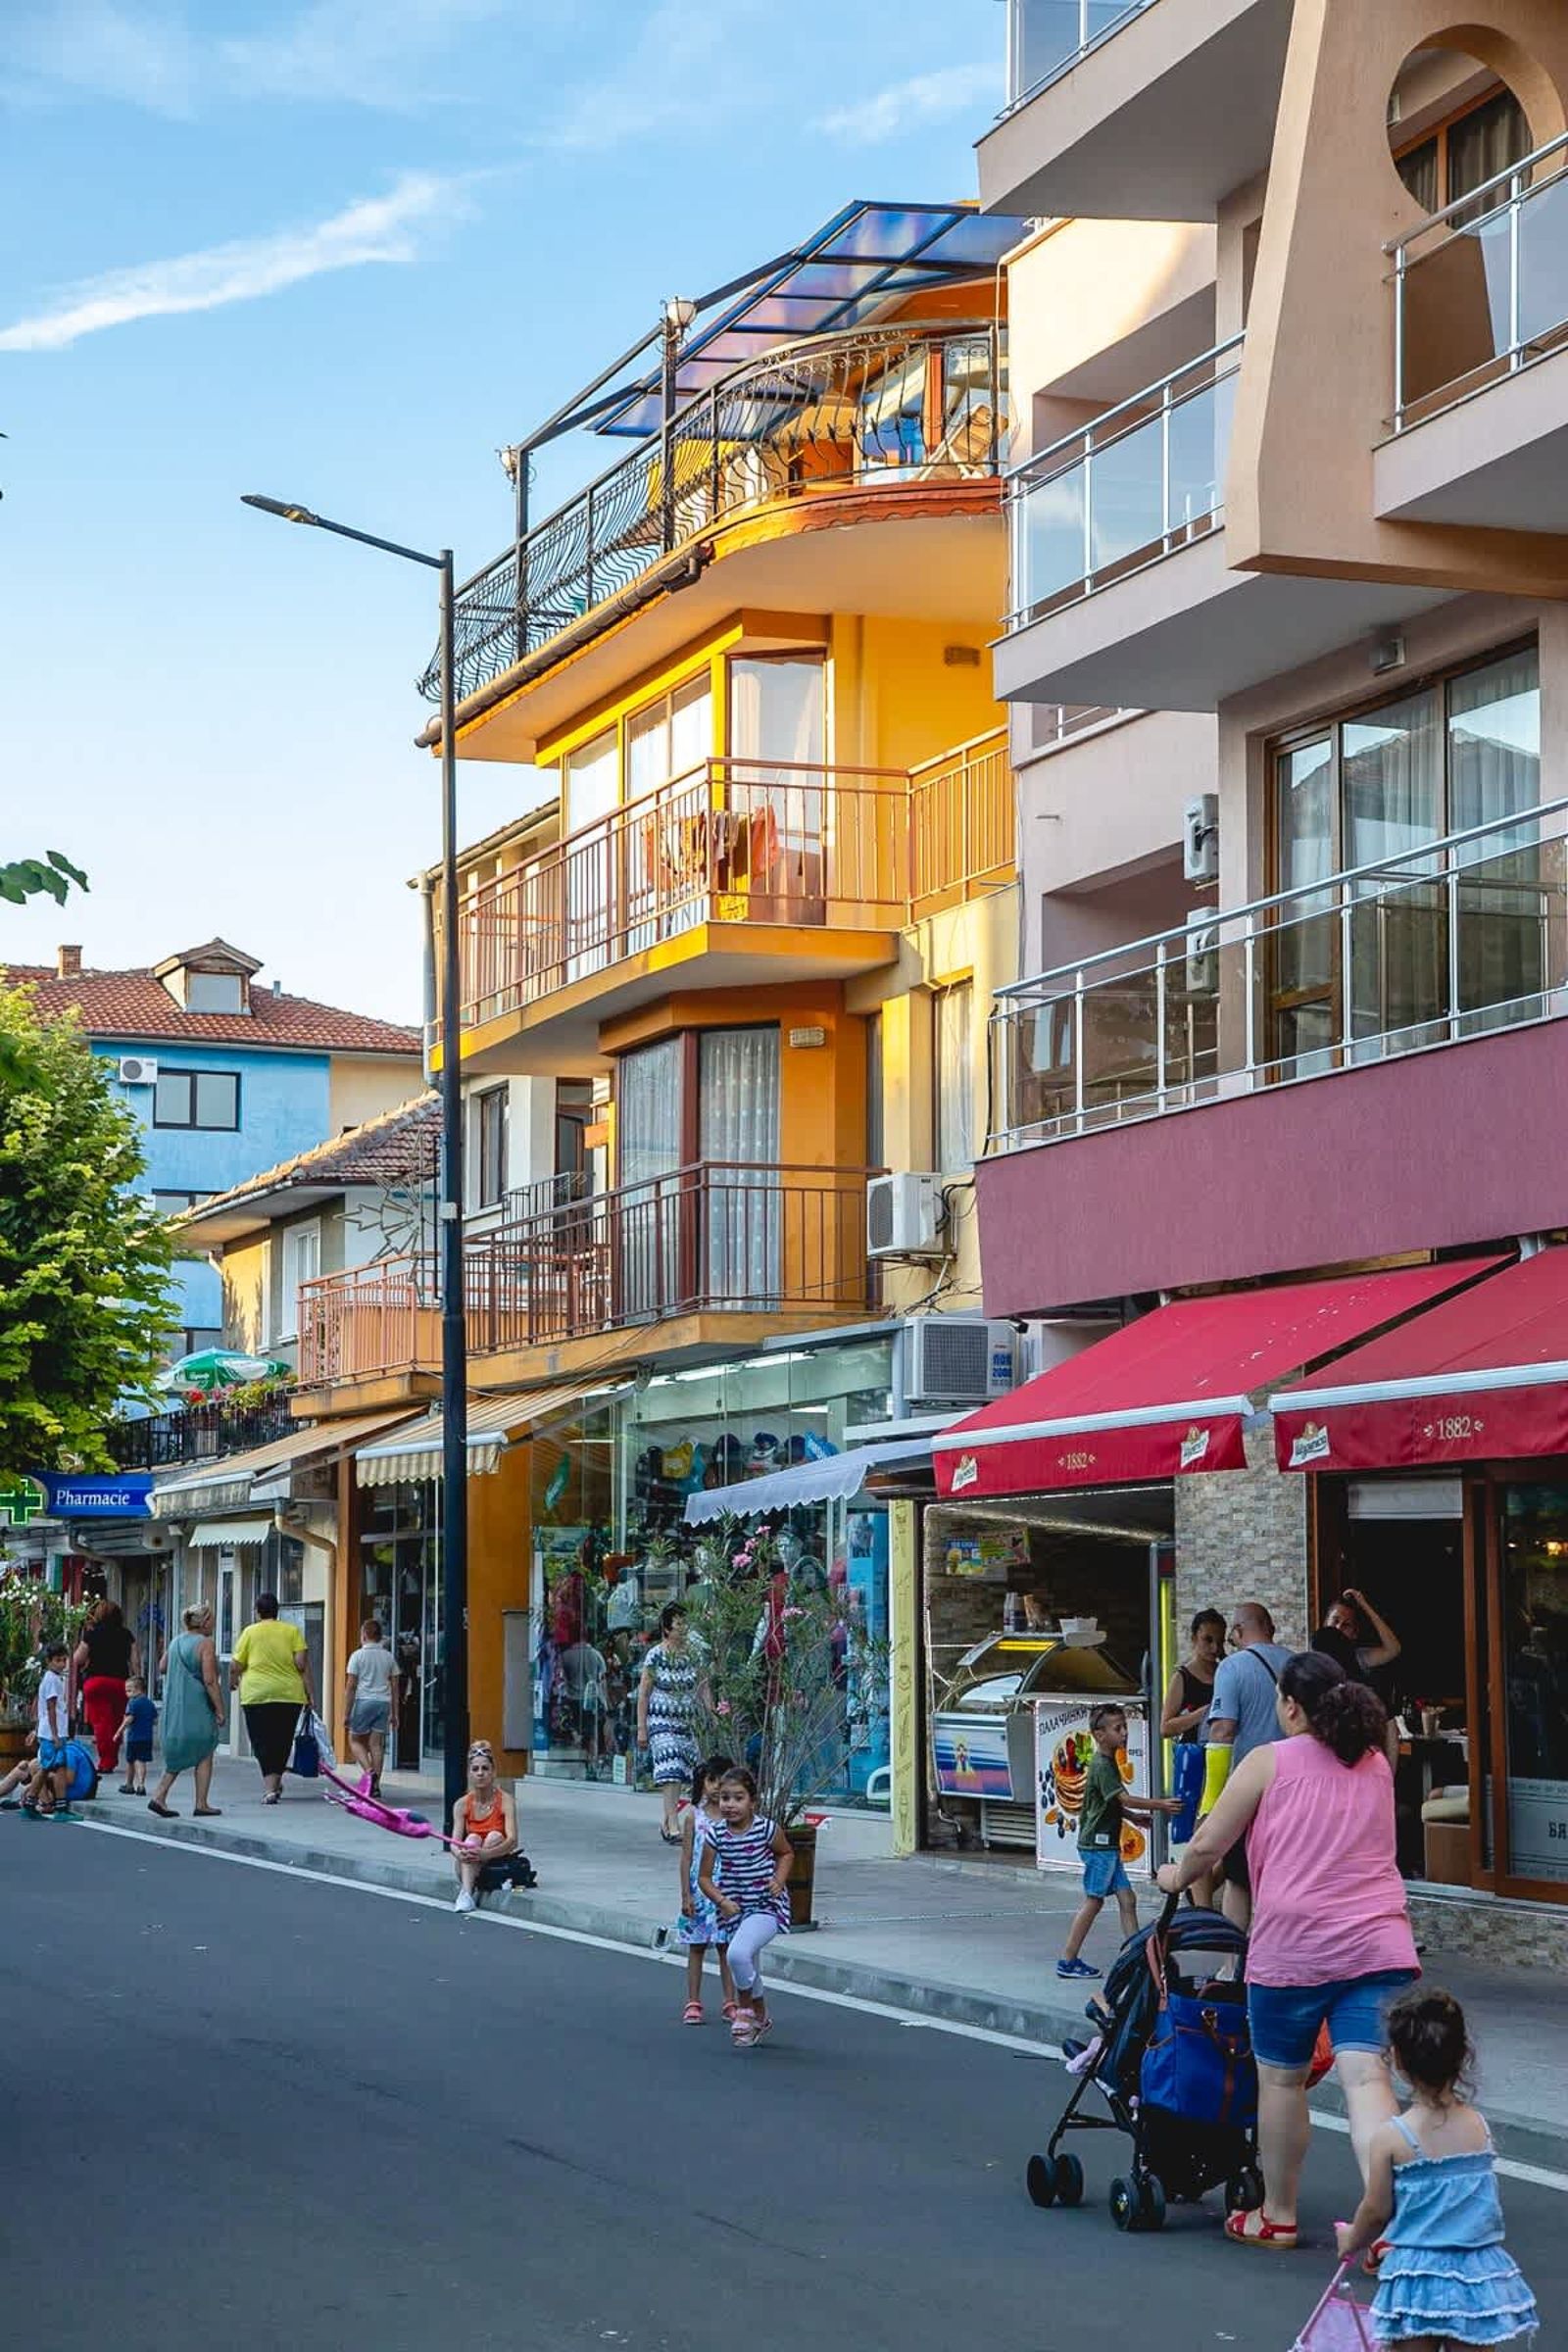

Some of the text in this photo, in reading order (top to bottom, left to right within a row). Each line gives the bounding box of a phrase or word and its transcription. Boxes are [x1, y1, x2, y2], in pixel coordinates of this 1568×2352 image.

[1436, 1415, 1471, 1441] 1882
[1065, 1452, 1089, 1470] 1882
[54, 1489, 130, 1506] Pharmacie
